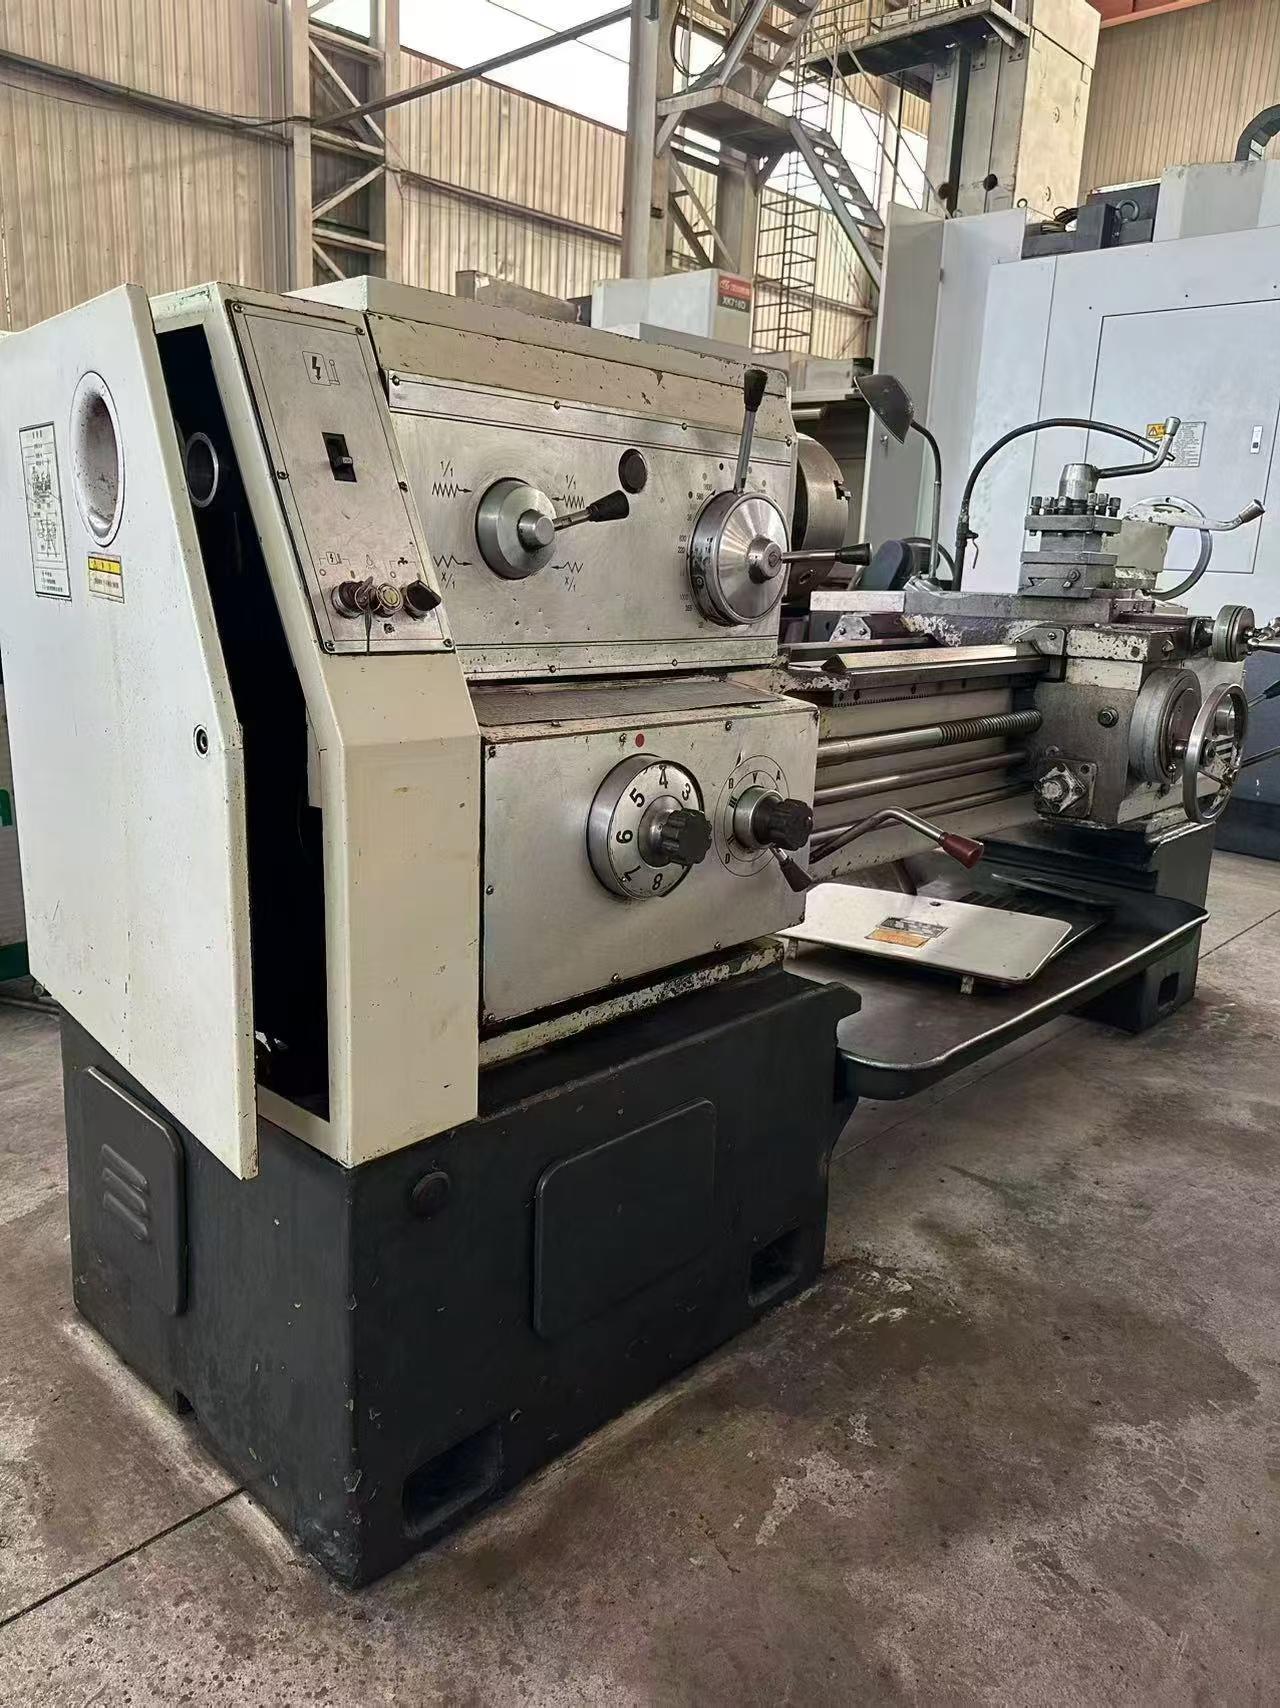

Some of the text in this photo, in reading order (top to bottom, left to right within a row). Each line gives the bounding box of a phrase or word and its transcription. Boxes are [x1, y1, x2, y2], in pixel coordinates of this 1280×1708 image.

[659, 765, 668, 789] 4
[776, 770, 781, 781] A
[629, 787, 645, 808] 5
[682, 783, 691, 801] 3
[616, 830, 633, 844] 6
[623, 865, 641, 882] 7
[652, 873, 663, 891] 8
